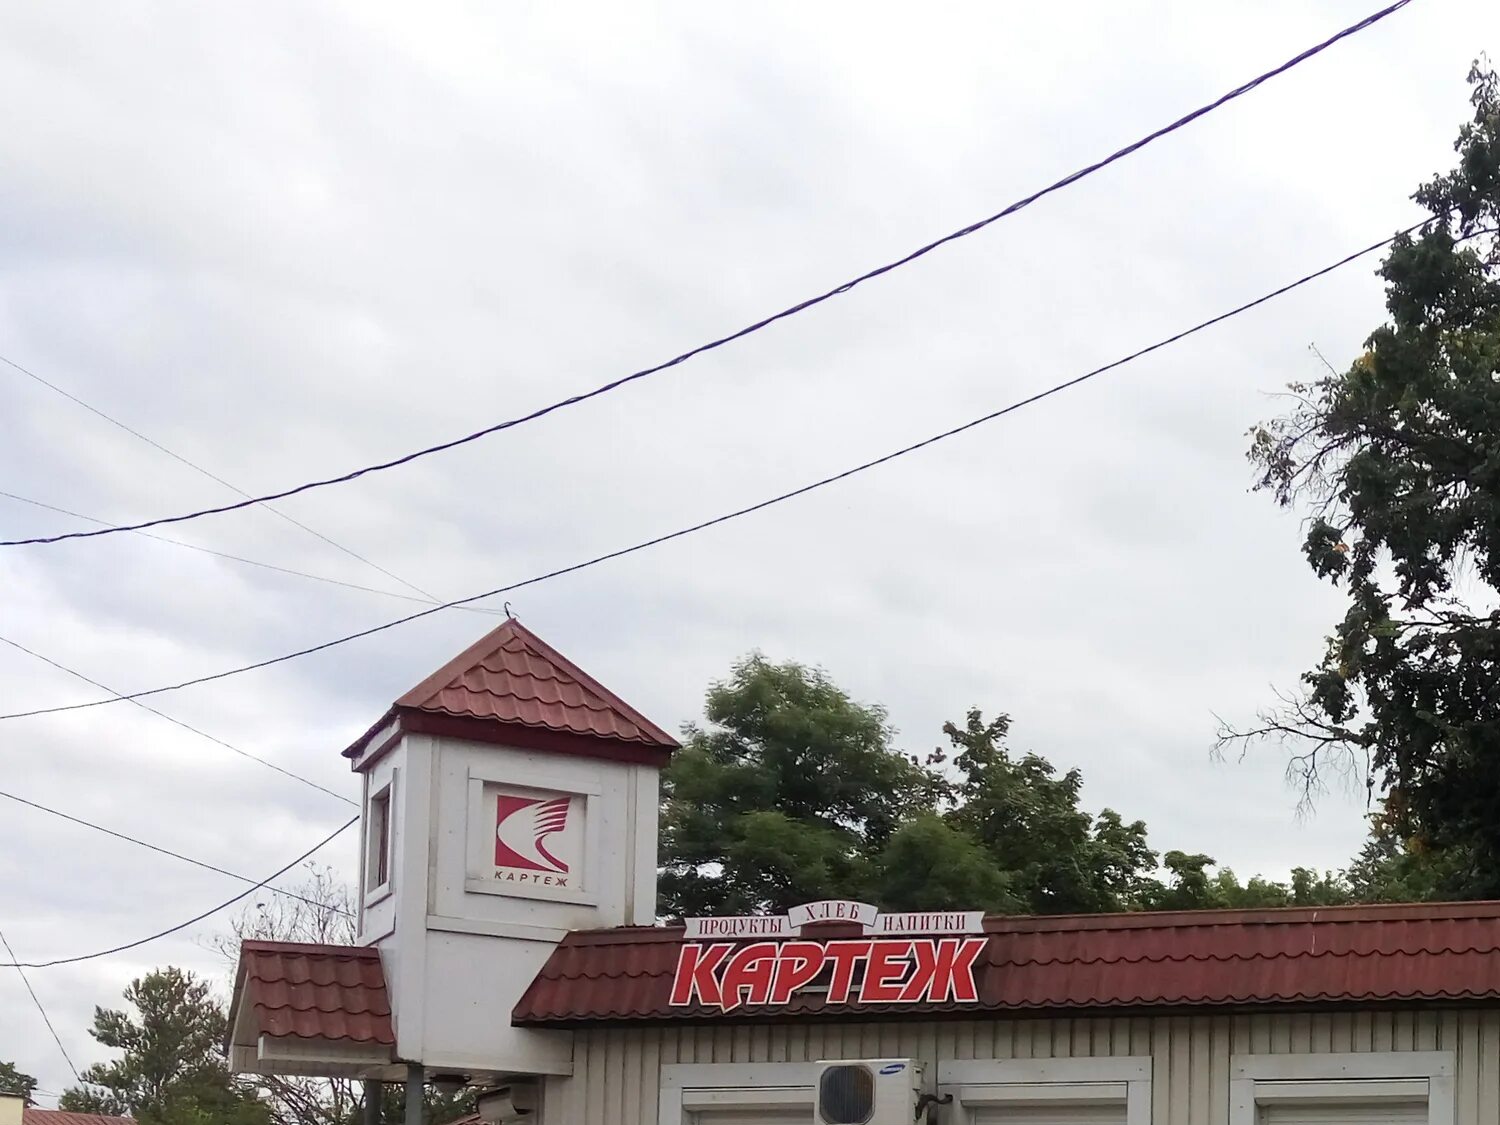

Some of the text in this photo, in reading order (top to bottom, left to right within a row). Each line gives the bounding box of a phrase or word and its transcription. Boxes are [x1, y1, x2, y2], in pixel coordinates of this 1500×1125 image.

[494, 871, 568, 887] КАРТЕЖ
[805, 902, 860, 921] ХЛЕБ
[699, 913, 966, 936] ПРОДУКТЫ НАПИТКИ
[669, 937, 988, 1013] КАРТЕЖ
